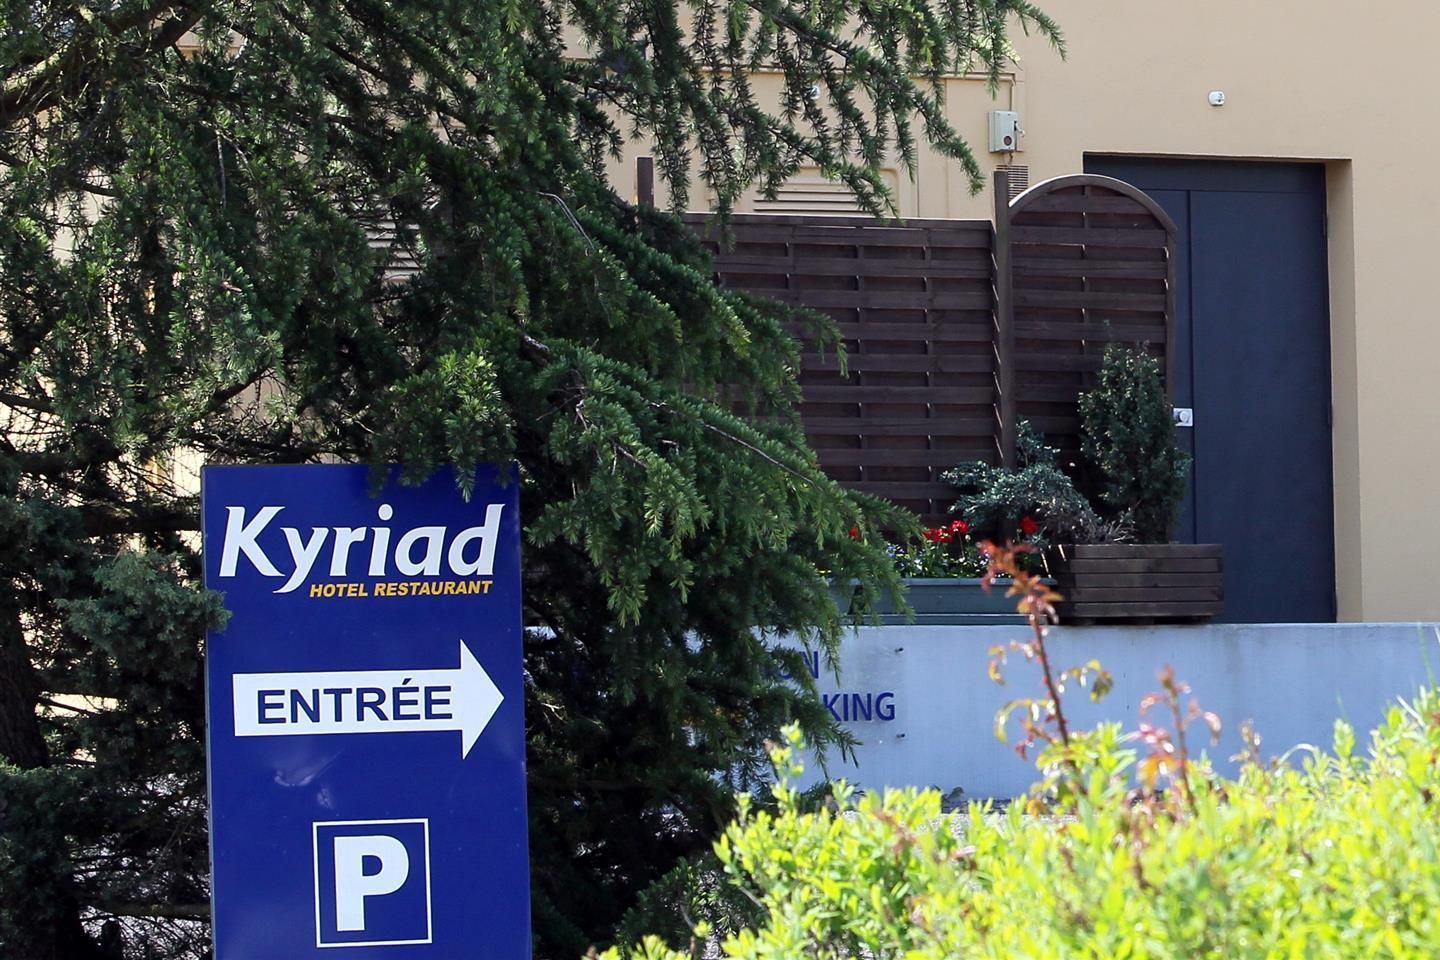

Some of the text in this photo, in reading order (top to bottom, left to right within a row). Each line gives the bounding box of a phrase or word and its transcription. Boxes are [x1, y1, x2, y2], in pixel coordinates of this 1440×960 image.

[219, 503, 506, 594] Kyriad
[309, 580, 493, 598] HOTEL RESTAURANT
[257, 677, 453, 725] ENTRÉE
[823, 692, 896, 722] KING
[334, 836, 409, 932] P
